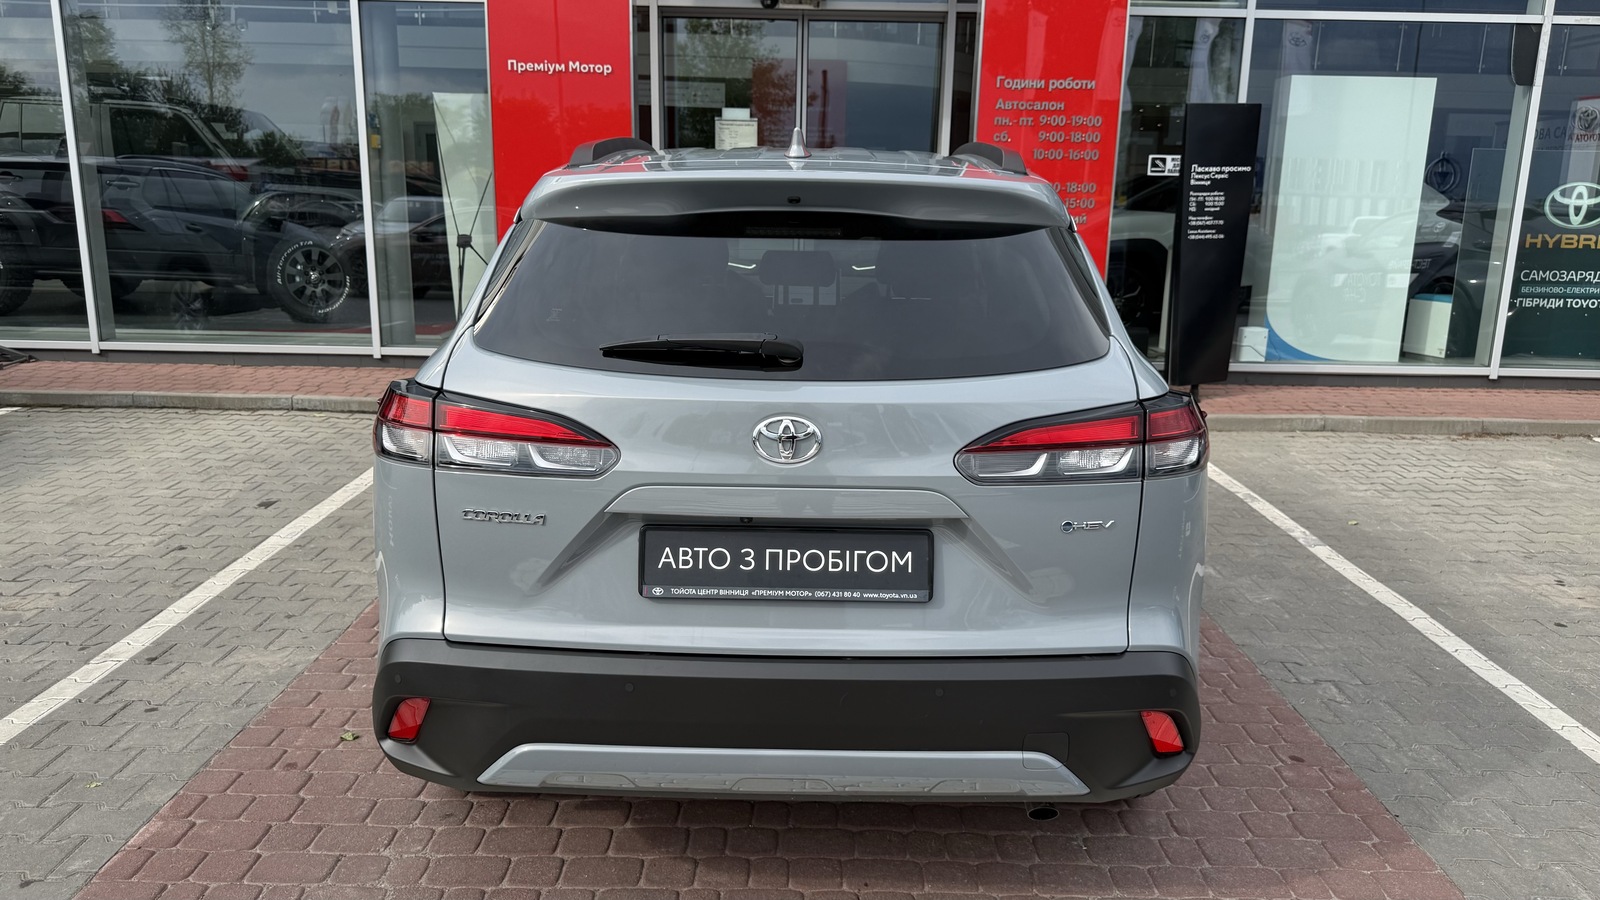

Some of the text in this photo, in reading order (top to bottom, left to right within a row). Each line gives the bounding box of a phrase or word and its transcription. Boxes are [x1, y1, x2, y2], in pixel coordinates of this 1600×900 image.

[507, 59, 612, 76] Преміум Мотор
[996, 76, 1096, 92] Години роботи
[995, 98, 1065, 111] Автосалон
[1039, 115, 1103, 127] 9:00-19:00
[993, 131, 1101, 143] сб. 9:00-18:00
[1033, 149, 1100, 161] 10:00-16:00
[1190, 163, 1221, 173] Ласкаво
[1221, 166, 1252, 174] просимо
[1516, 297, 1564, 309] ГІБРИДИ
[462, 508, 546, 526] COROLLA
[658, 546, 913, 573] АВТО З ПРОБІГОМ
[814, 590, 831, 598] (067)
[862, 592, 918, 600] www.toyota.vn.ua
